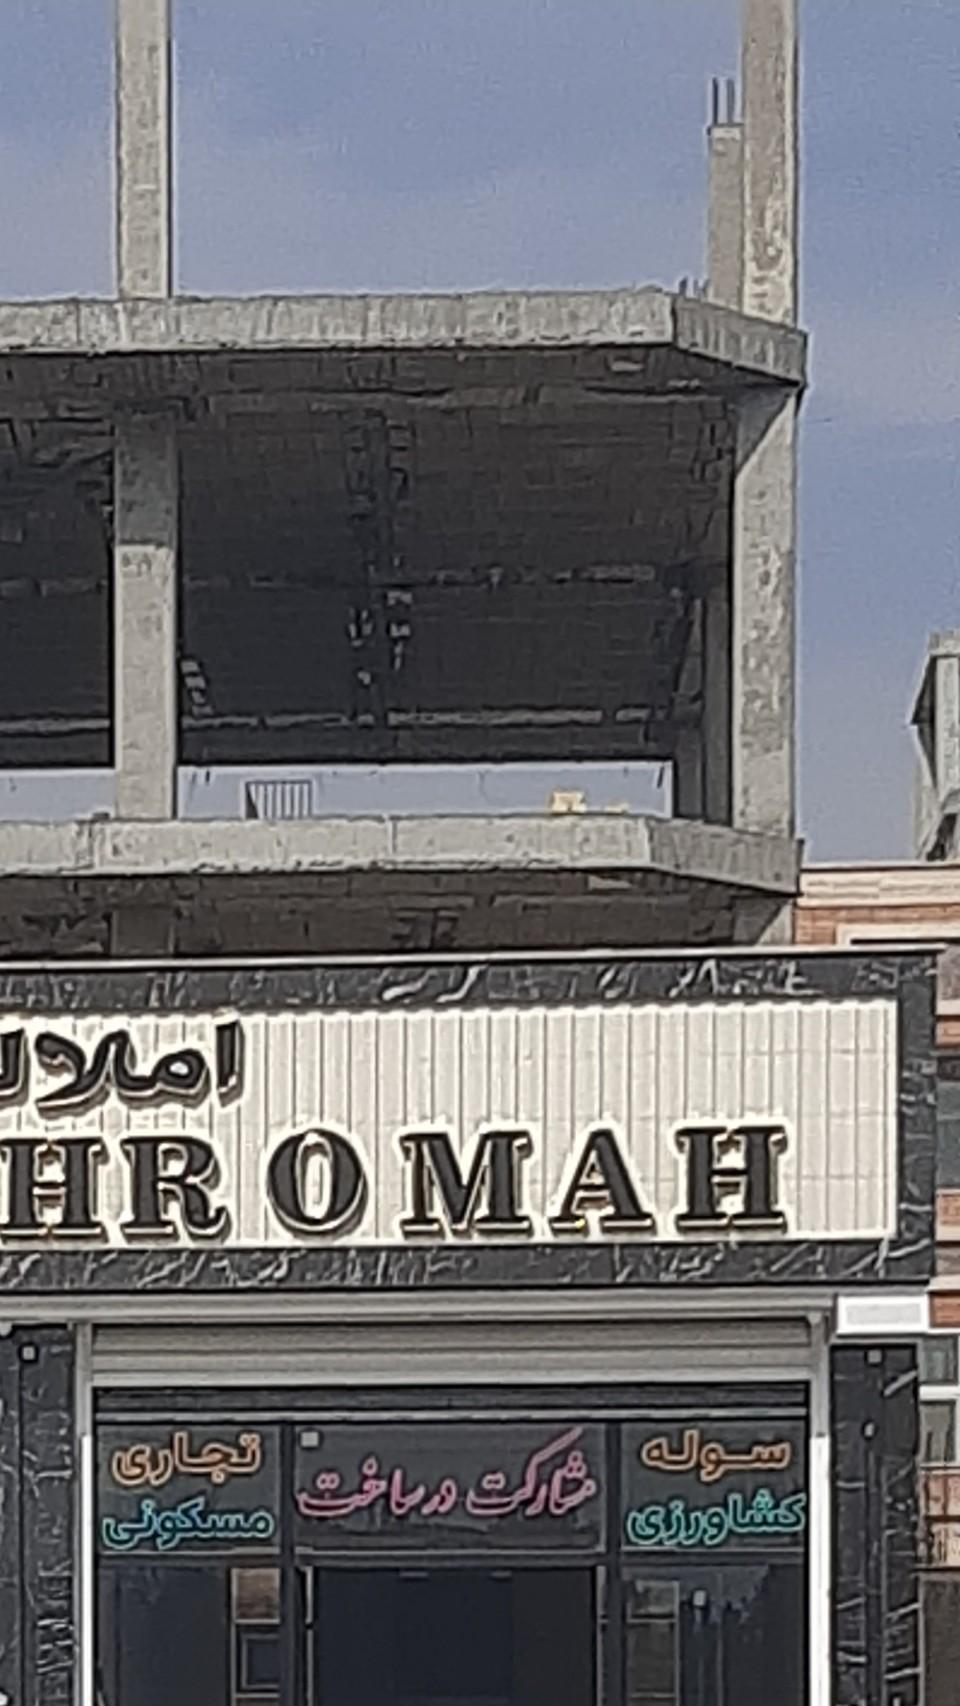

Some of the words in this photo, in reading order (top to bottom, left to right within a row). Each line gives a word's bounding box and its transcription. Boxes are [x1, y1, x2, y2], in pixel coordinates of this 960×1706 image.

[112, 1431, 262, 1486] تجاری
[466, 1426, 597, 1516] مشارکت
[640, 1429, 791, 1482] سوله
[102, 1497, 274, 1550] مسکونی
[627, 1488, 807, 1546] کشاورزی
